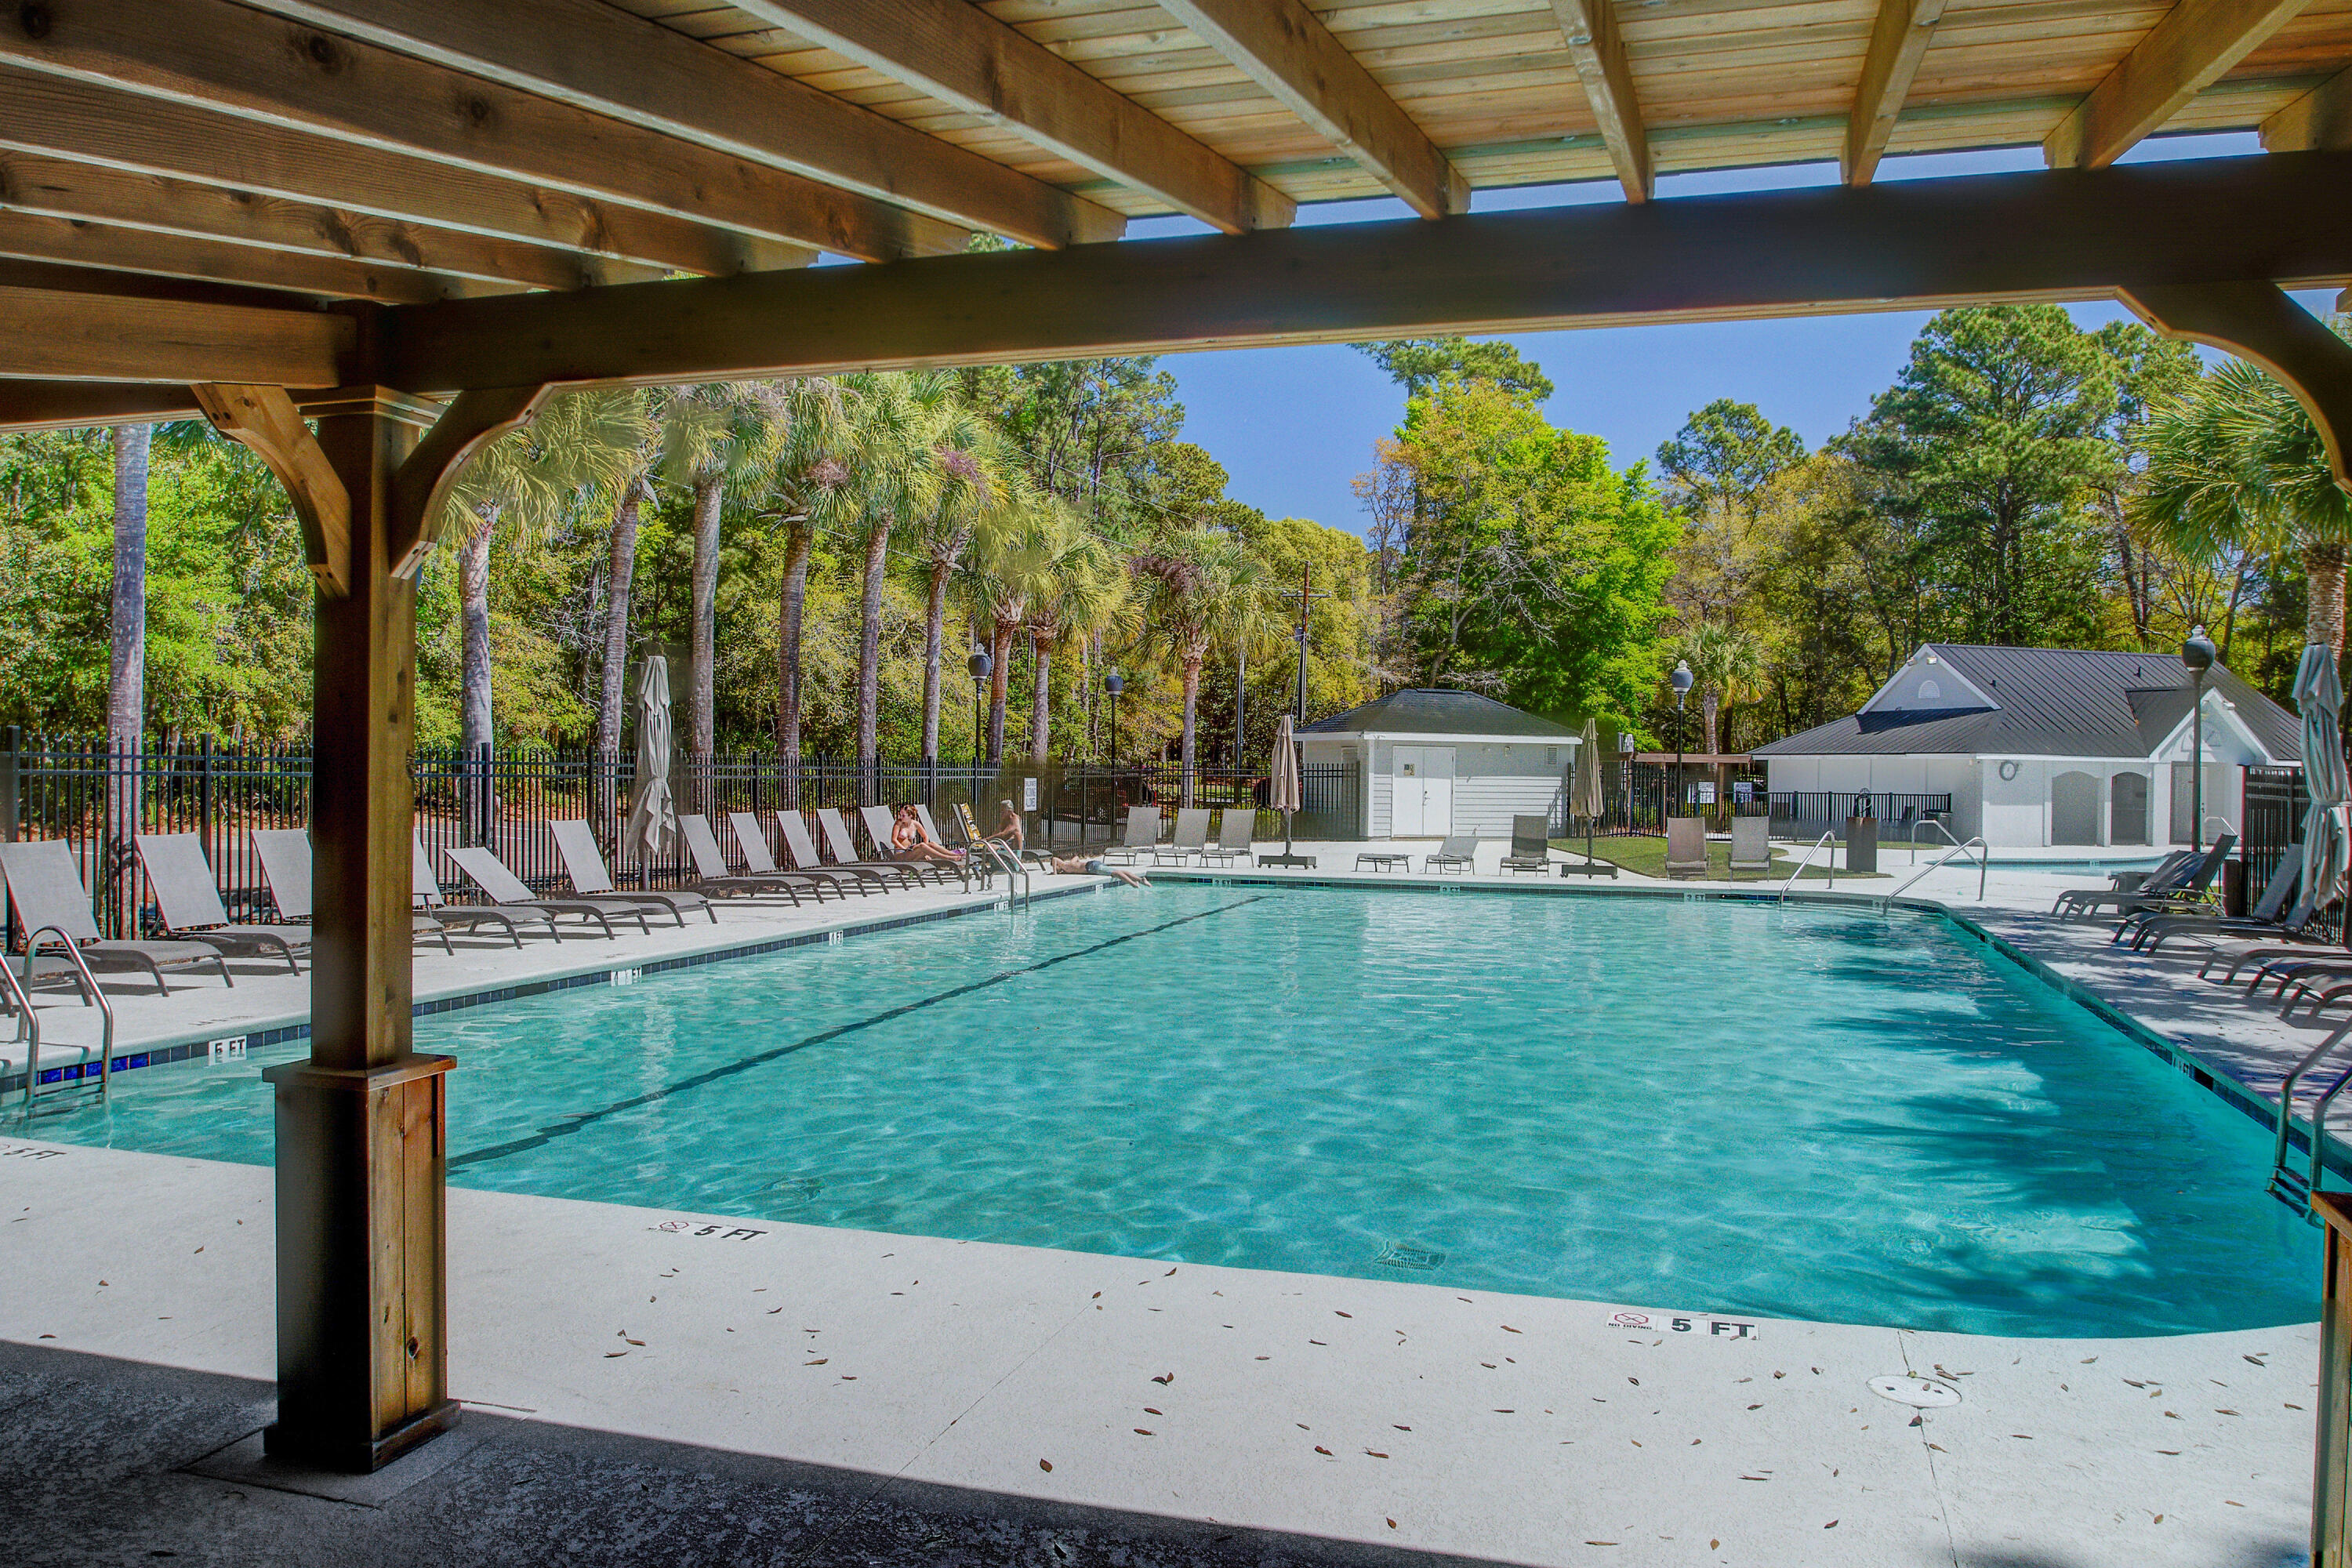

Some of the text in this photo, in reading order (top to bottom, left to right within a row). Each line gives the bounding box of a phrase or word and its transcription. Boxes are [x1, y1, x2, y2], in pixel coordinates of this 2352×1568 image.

[229, 1039, 245, 1053] FT
[20, 1150, 67, 1160] FT
[694, 1225, 723, 1236] 5
[720, 1228, 769, 1241] FT
[1671, 1317, 1755, 1338] 5 FT
